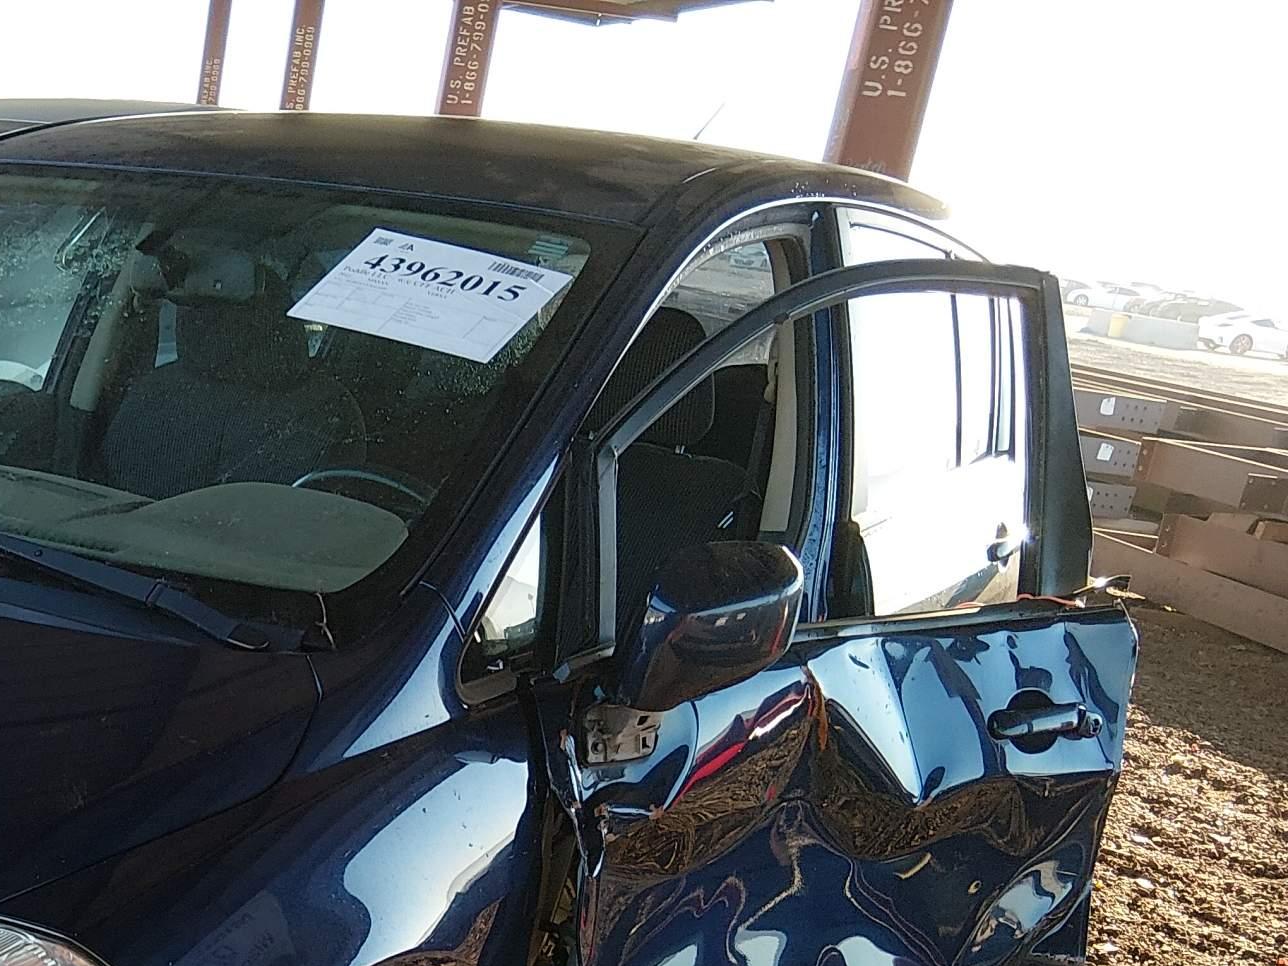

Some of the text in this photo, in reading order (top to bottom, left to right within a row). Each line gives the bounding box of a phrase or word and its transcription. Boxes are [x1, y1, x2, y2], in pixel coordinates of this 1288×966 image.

[288, 51, 302, 93] PREFAB
[295, 24, 306, 46] INC.
[446, 6, 475, 104] U.S. PREFAB
[461, 0, 490, 104] 1-866-799-0
[862, 48, 892, 97] U.S.
[364, 254, 527, 301] 43962015
